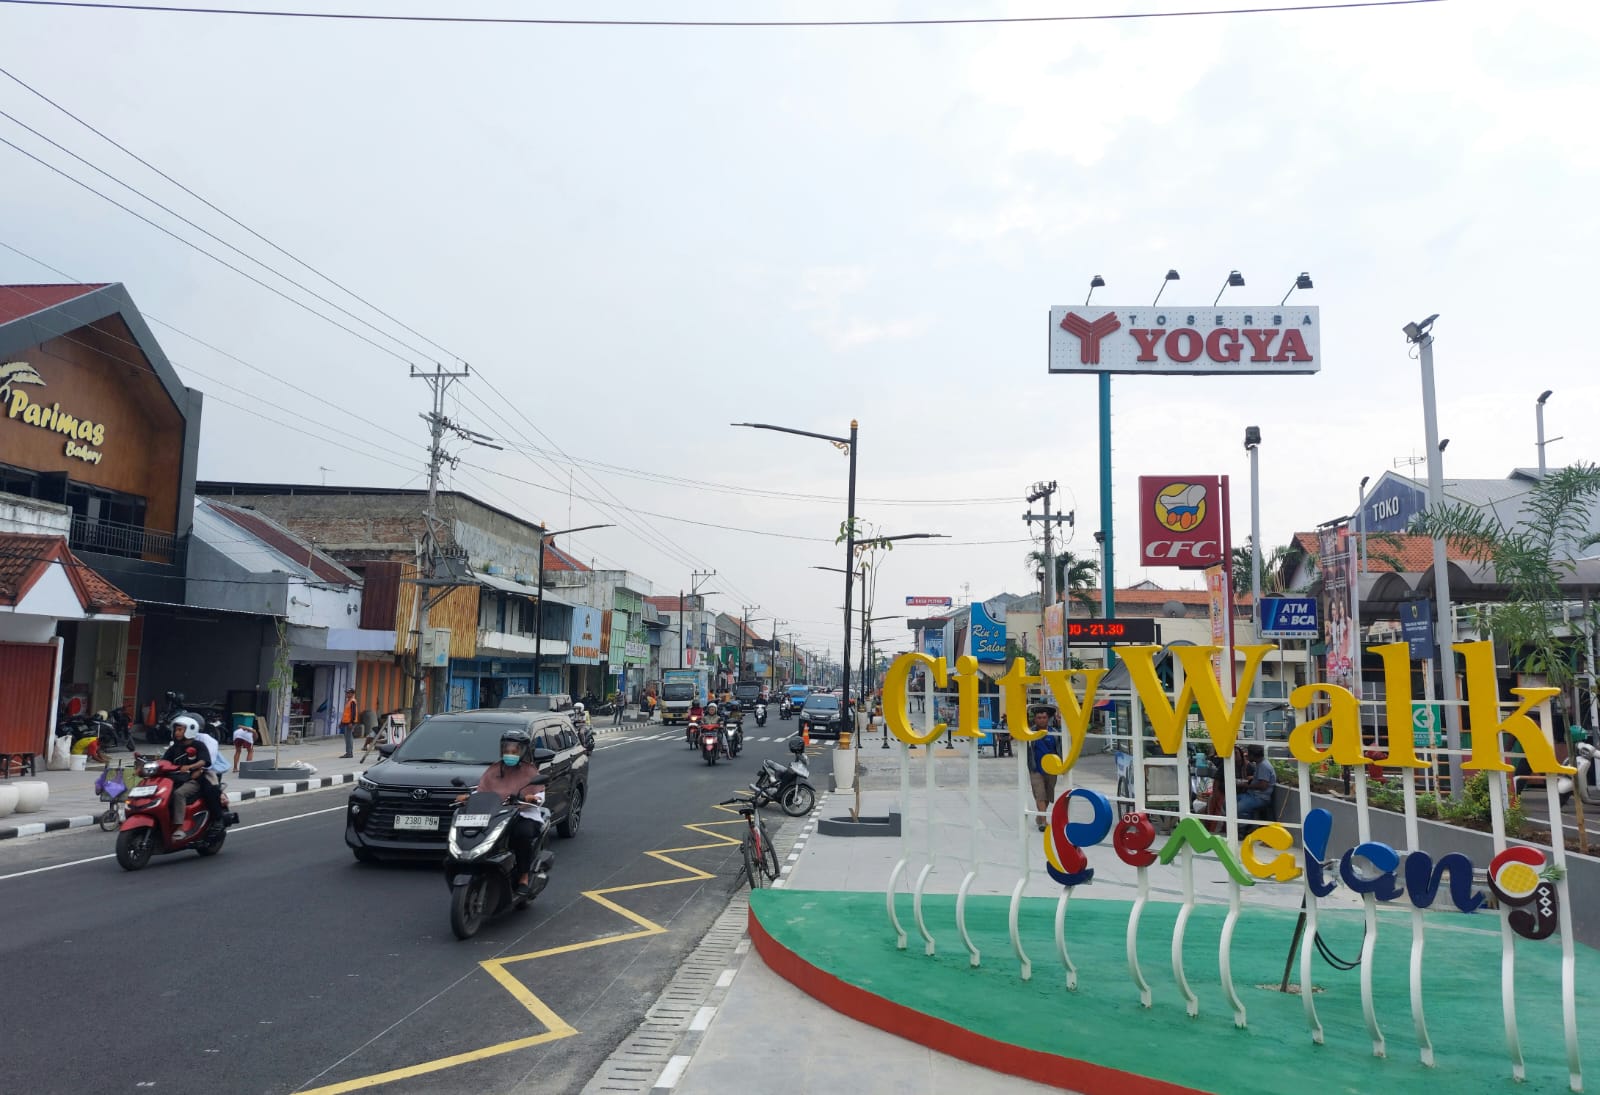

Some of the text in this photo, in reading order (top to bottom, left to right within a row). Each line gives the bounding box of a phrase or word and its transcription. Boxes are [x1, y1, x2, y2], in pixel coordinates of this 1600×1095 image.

[1129, 315, 1312, 326] TOSERBA
[1129, 327, 1314, 362] YOGYA
[9, 389, 105, 446] Parimas
[1372, 495, 1400, 522] TOKO
[1145, 540, 1217, 558] CFC
[1281, 603, 1308, 613] ATM
[1291, 615, 1315, 625] BCA
[972, 624, 999, 638] Rin's
[977, 639, 1006, 652] Salon
